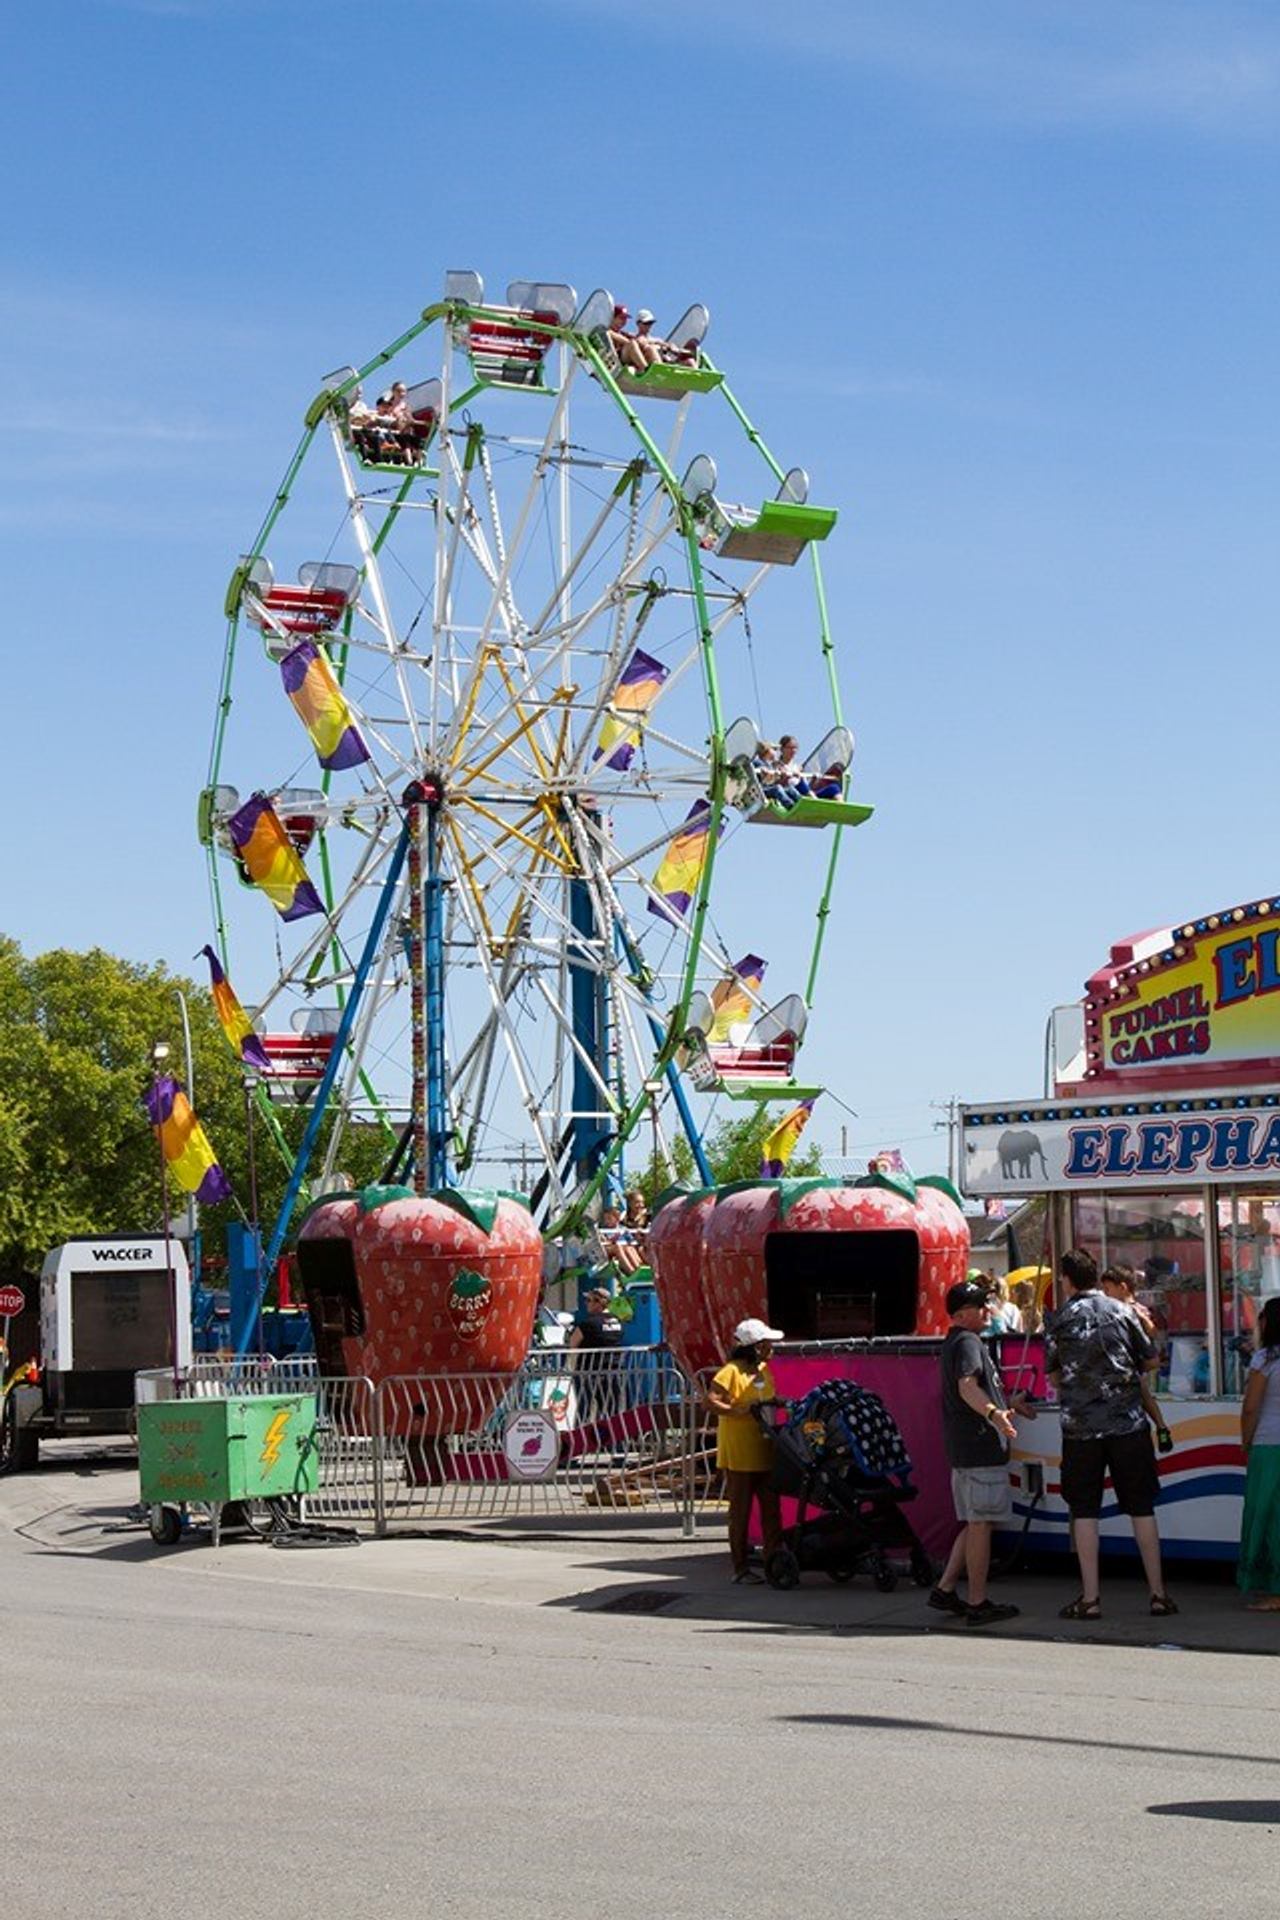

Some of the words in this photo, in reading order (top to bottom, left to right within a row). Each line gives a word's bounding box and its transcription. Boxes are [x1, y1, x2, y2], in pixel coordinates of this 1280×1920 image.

[1109, 983, 1210, 1039] FUNNEL
[1111, 1020, 1211, 1065] CAKES
[92, 1248, 153, 1261] WACKER
[449, 1289, 491, 1311] BERRY
